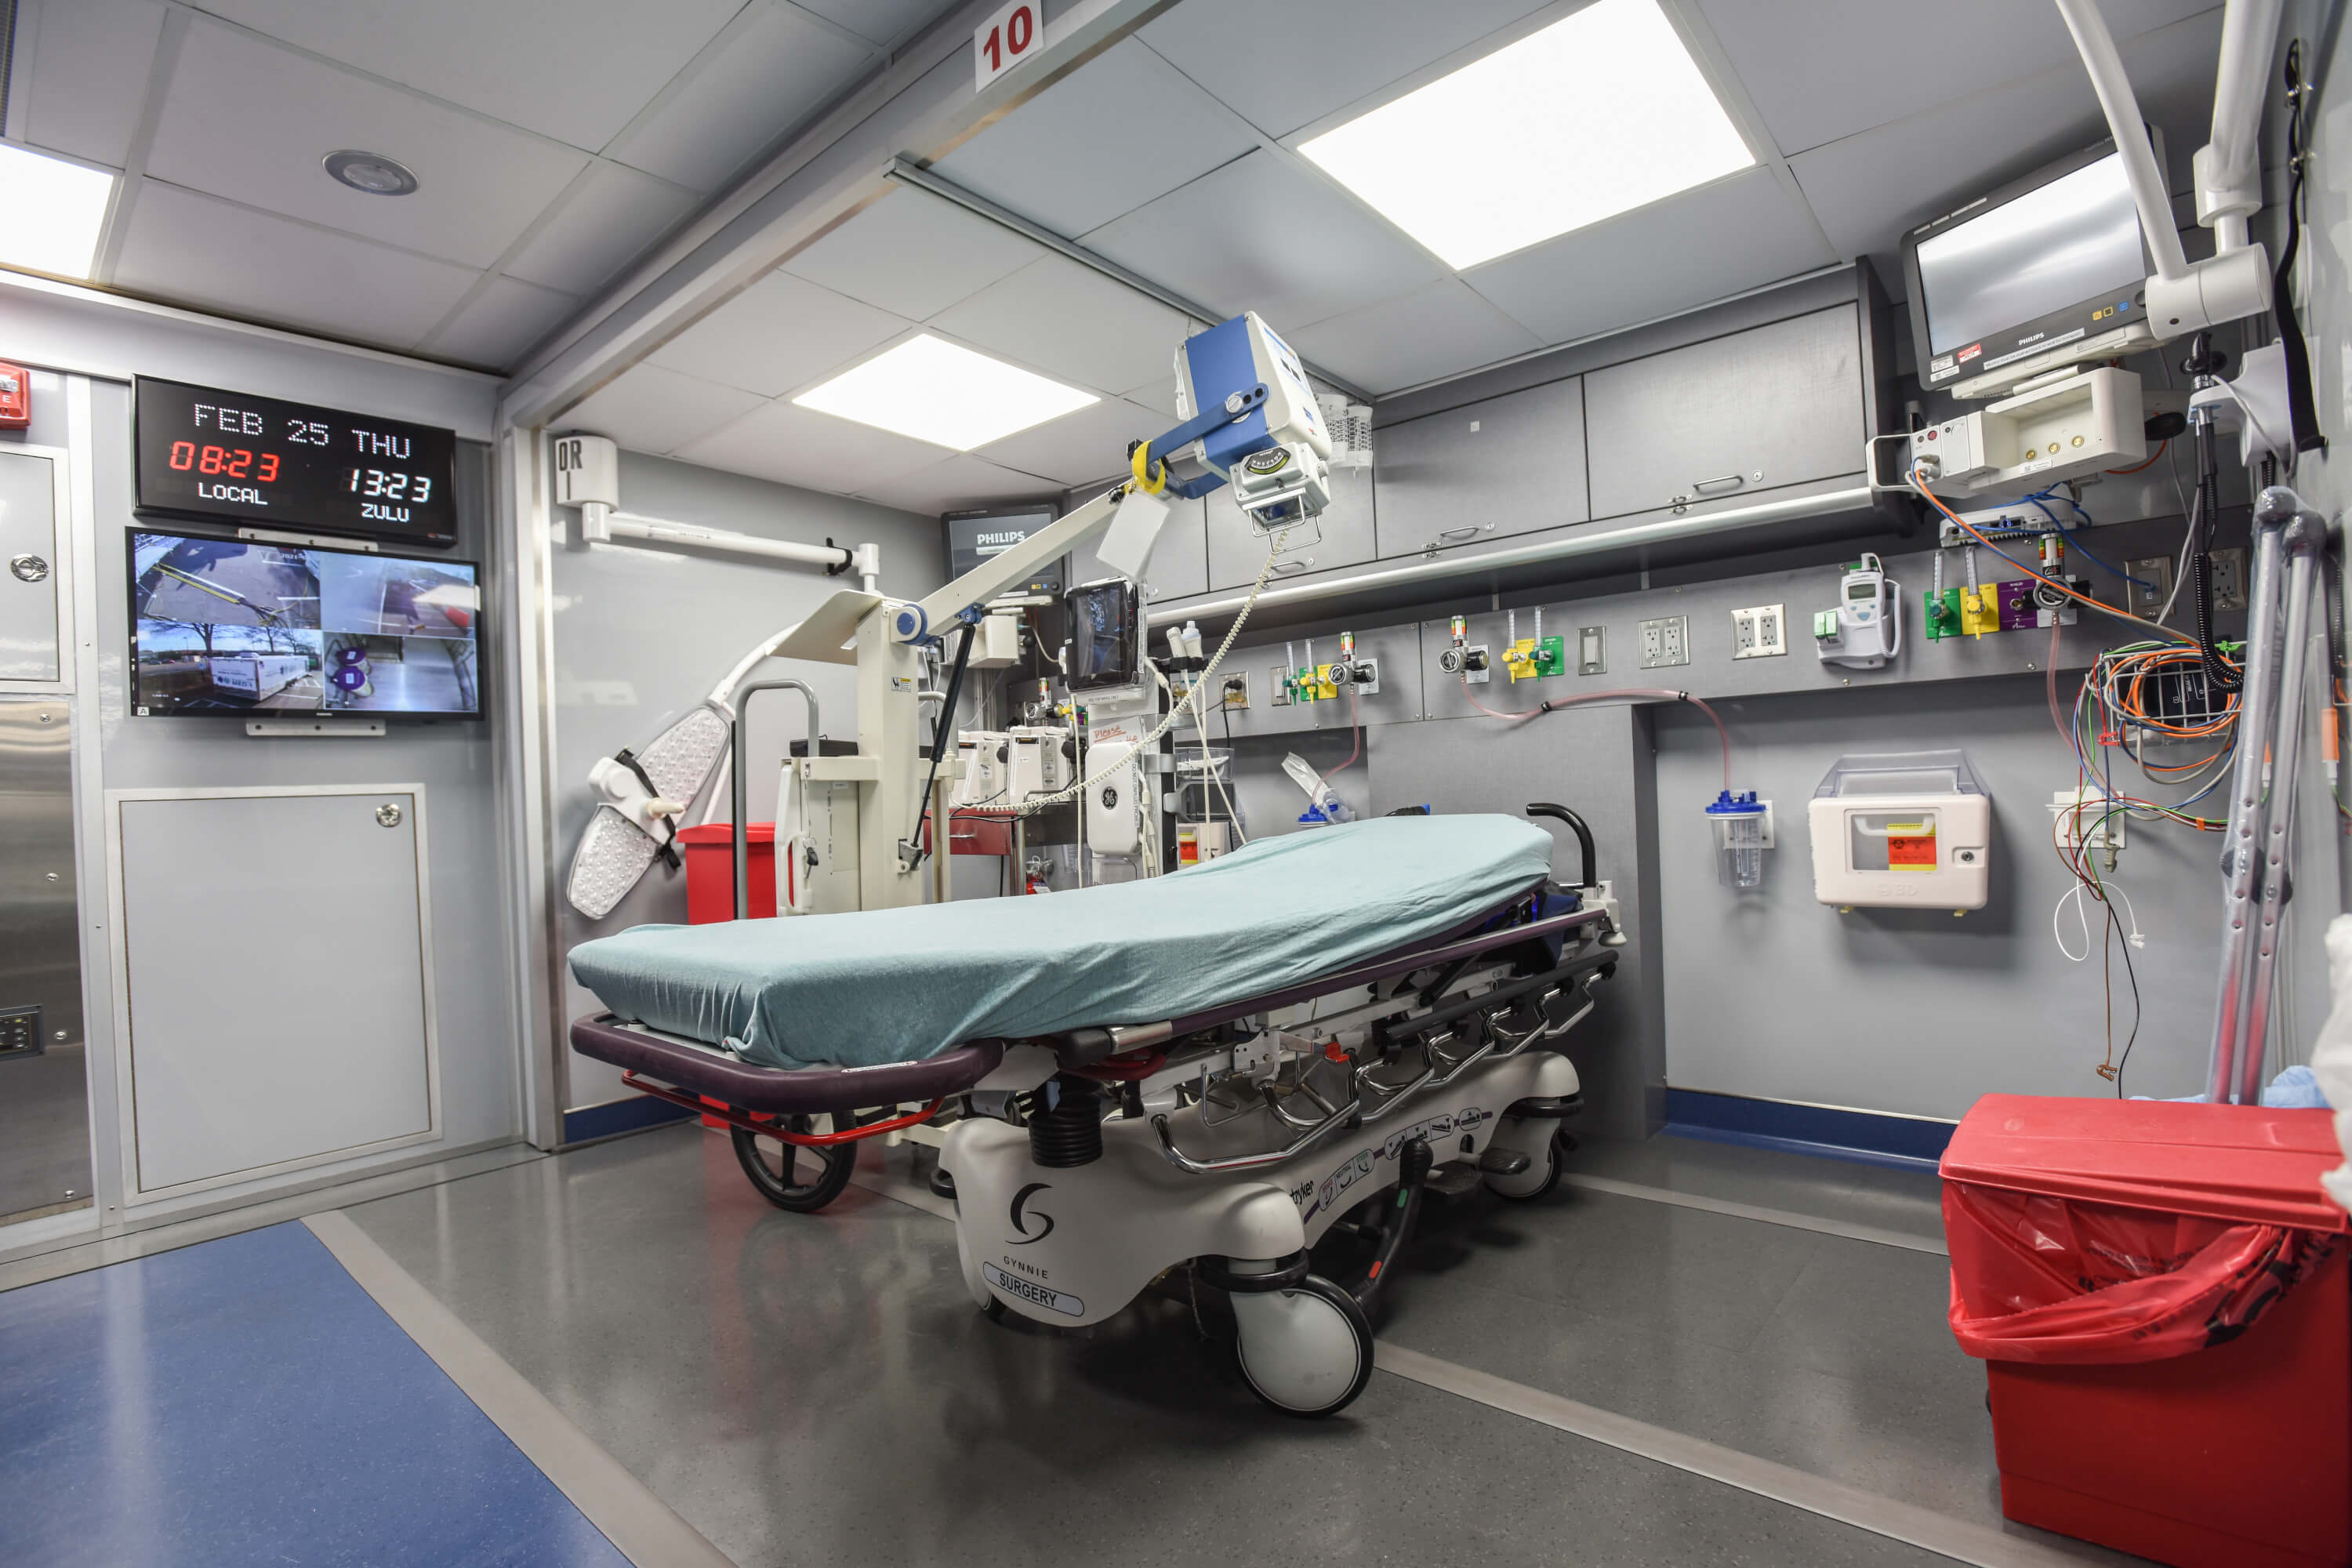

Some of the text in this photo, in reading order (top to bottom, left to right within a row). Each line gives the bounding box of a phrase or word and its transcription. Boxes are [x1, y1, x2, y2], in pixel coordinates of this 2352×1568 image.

[983, 5, 1033, 72] 10
[2018, 332, 2045, 345] PHILIPS
[194, 403, 410, 459] FEB 25 THU
[169, 441, 280, 482] 08:23
[559, 440, 583, 471] OR
[198, 482, 268, 506] LOCAL
[350, 468, 431, 503] 13:23
[361, 503, 410, 523] ZULU
[977, 531, 1025, 545] PHILIPS
[1094, 725, 1121, 739] Please
[1336, 1164, 1352, 1178] NEUTRAL
[1290, 1180, 1314, 1205] tryker
[1004, 1256, 1048, 1279] GYNNIE
[1000, 1273, 1057, 1307] SURGERY
